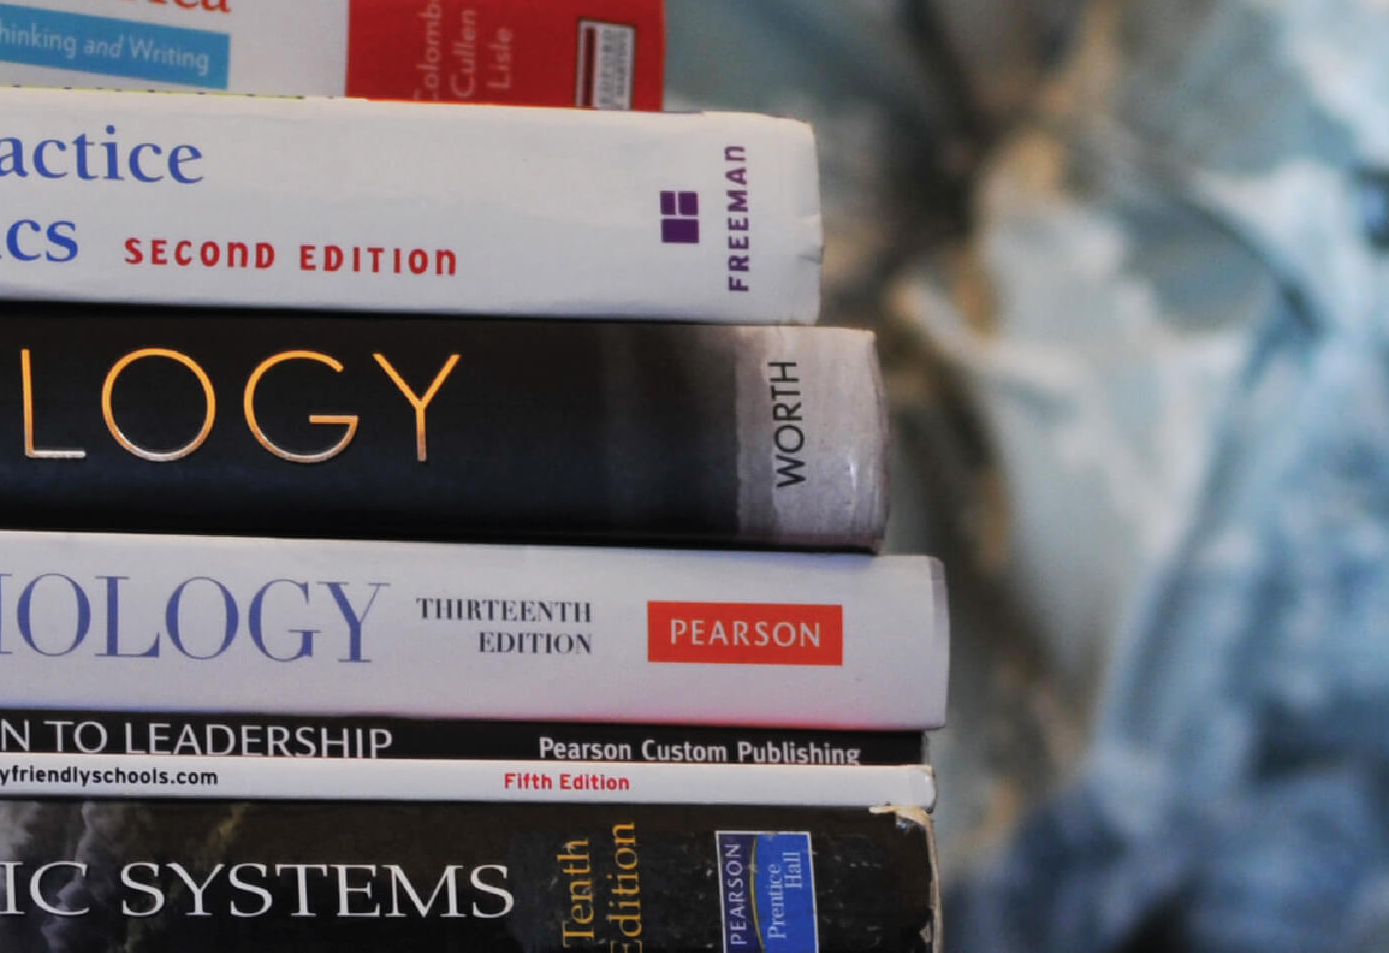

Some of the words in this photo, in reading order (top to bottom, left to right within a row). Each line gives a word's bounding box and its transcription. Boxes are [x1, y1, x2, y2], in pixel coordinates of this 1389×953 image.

[83, 36, 124, 59] and
[129, 36, 209, 75] Writing
[451, 10, 477, 98] Cullen
[487, 27, 512, 89] Lisle
[768, 360, 806, 487] WORTH
[417, 597, 592, 623] THIRTEENTH
[479, 631, 592, 654] EDITION
[669, 618, 821, 648] PEARSON
[44, 720, 109, 754] TO
[124, 723, 394, 759] LEADERSHIP
[539, 736, 631, 760] Pearson
[641, 739, 727, 762] Custom
[737, 741, 861, 765] Publishing
[504, 773, 552, 790] Fifth
[559, 774, 630, 791] Edition
[783, 851, 803, 889] Hall
[120, 862, 514, 920] SYSTEMS
[557, 839, 595, 948] Tenth
[725, 843, 748, 945] PEARSON
[767, 863, 787, 940] Prentice
